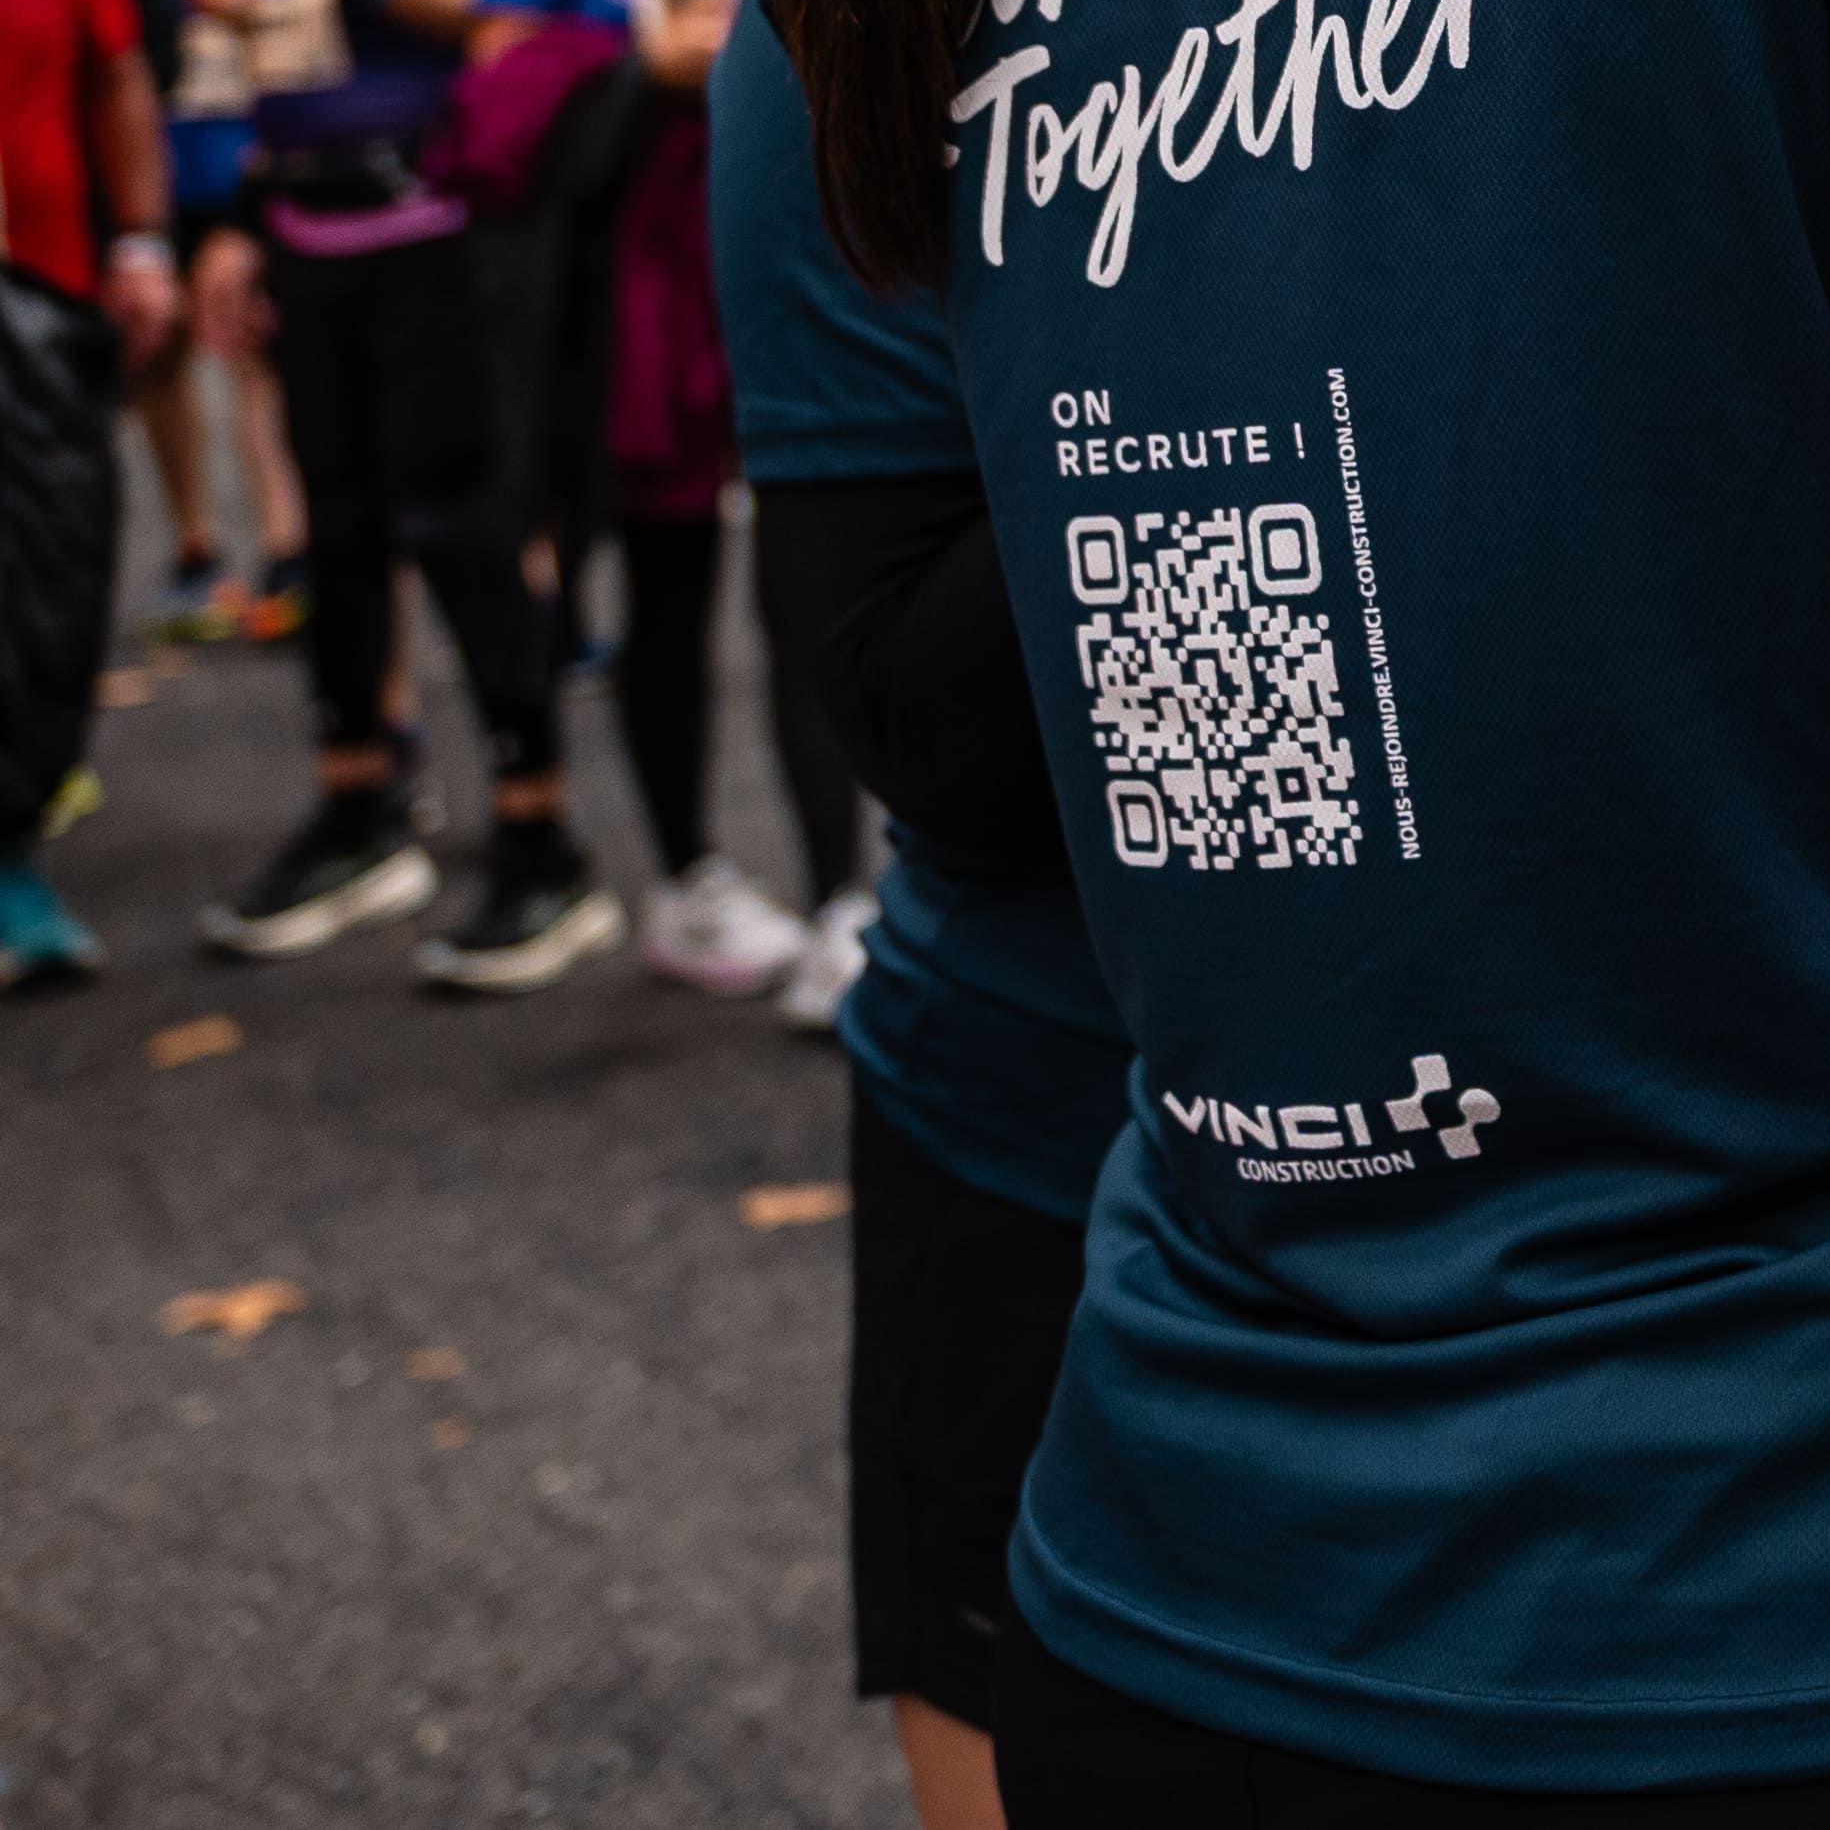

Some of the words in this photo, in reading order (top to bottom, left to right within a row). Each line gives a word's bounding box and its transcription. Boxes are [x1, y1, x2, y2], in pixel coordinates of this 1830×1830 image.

[1051, 389, 1113, 429] ON
[1056, 425, 1272, 477] RECRUTE
[1293, 422, 1306, 460] !
[1327, 366, 1422, 861] NOUS-REJOINDRE.VINCI-CONSTRUCTION.COM
[1161, 1090, 1373, 1151] VINCI
[1236, 1149, 1417, 1184] CONSTRUCTION
